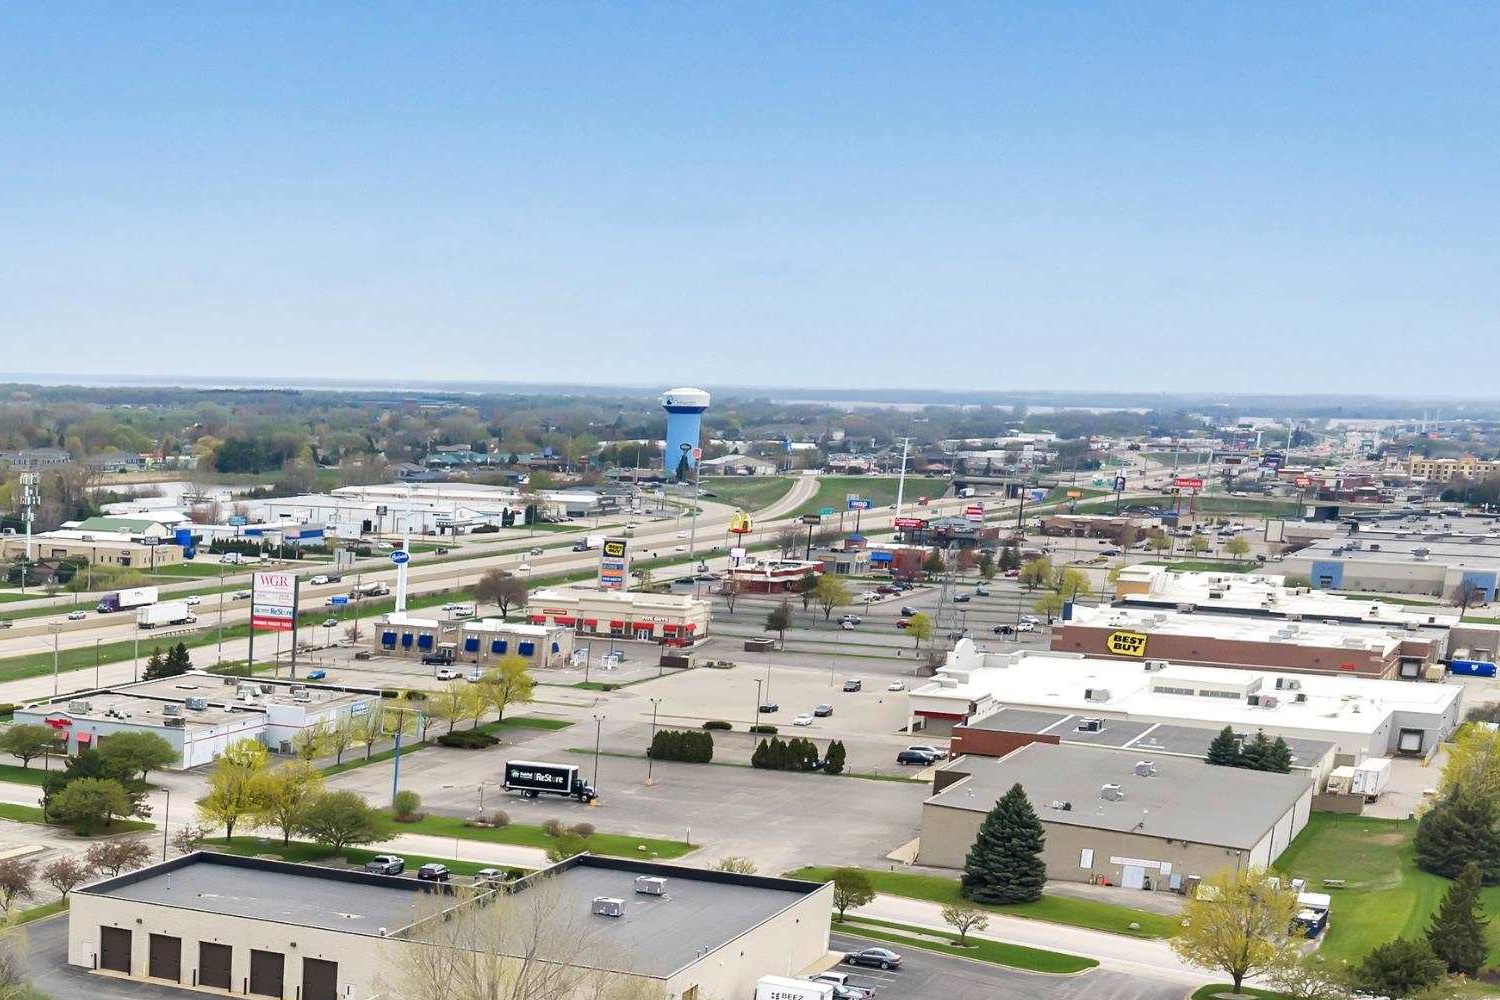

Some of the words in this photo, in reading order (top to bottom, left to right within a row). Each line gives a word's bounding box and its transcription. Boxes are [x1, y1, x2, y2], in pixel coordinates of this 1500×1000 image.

[1113, 634, 1145, 646] BEST
[1113, 642, 1140, 652] BUY
[536, 772, 564, 784] ReStore
